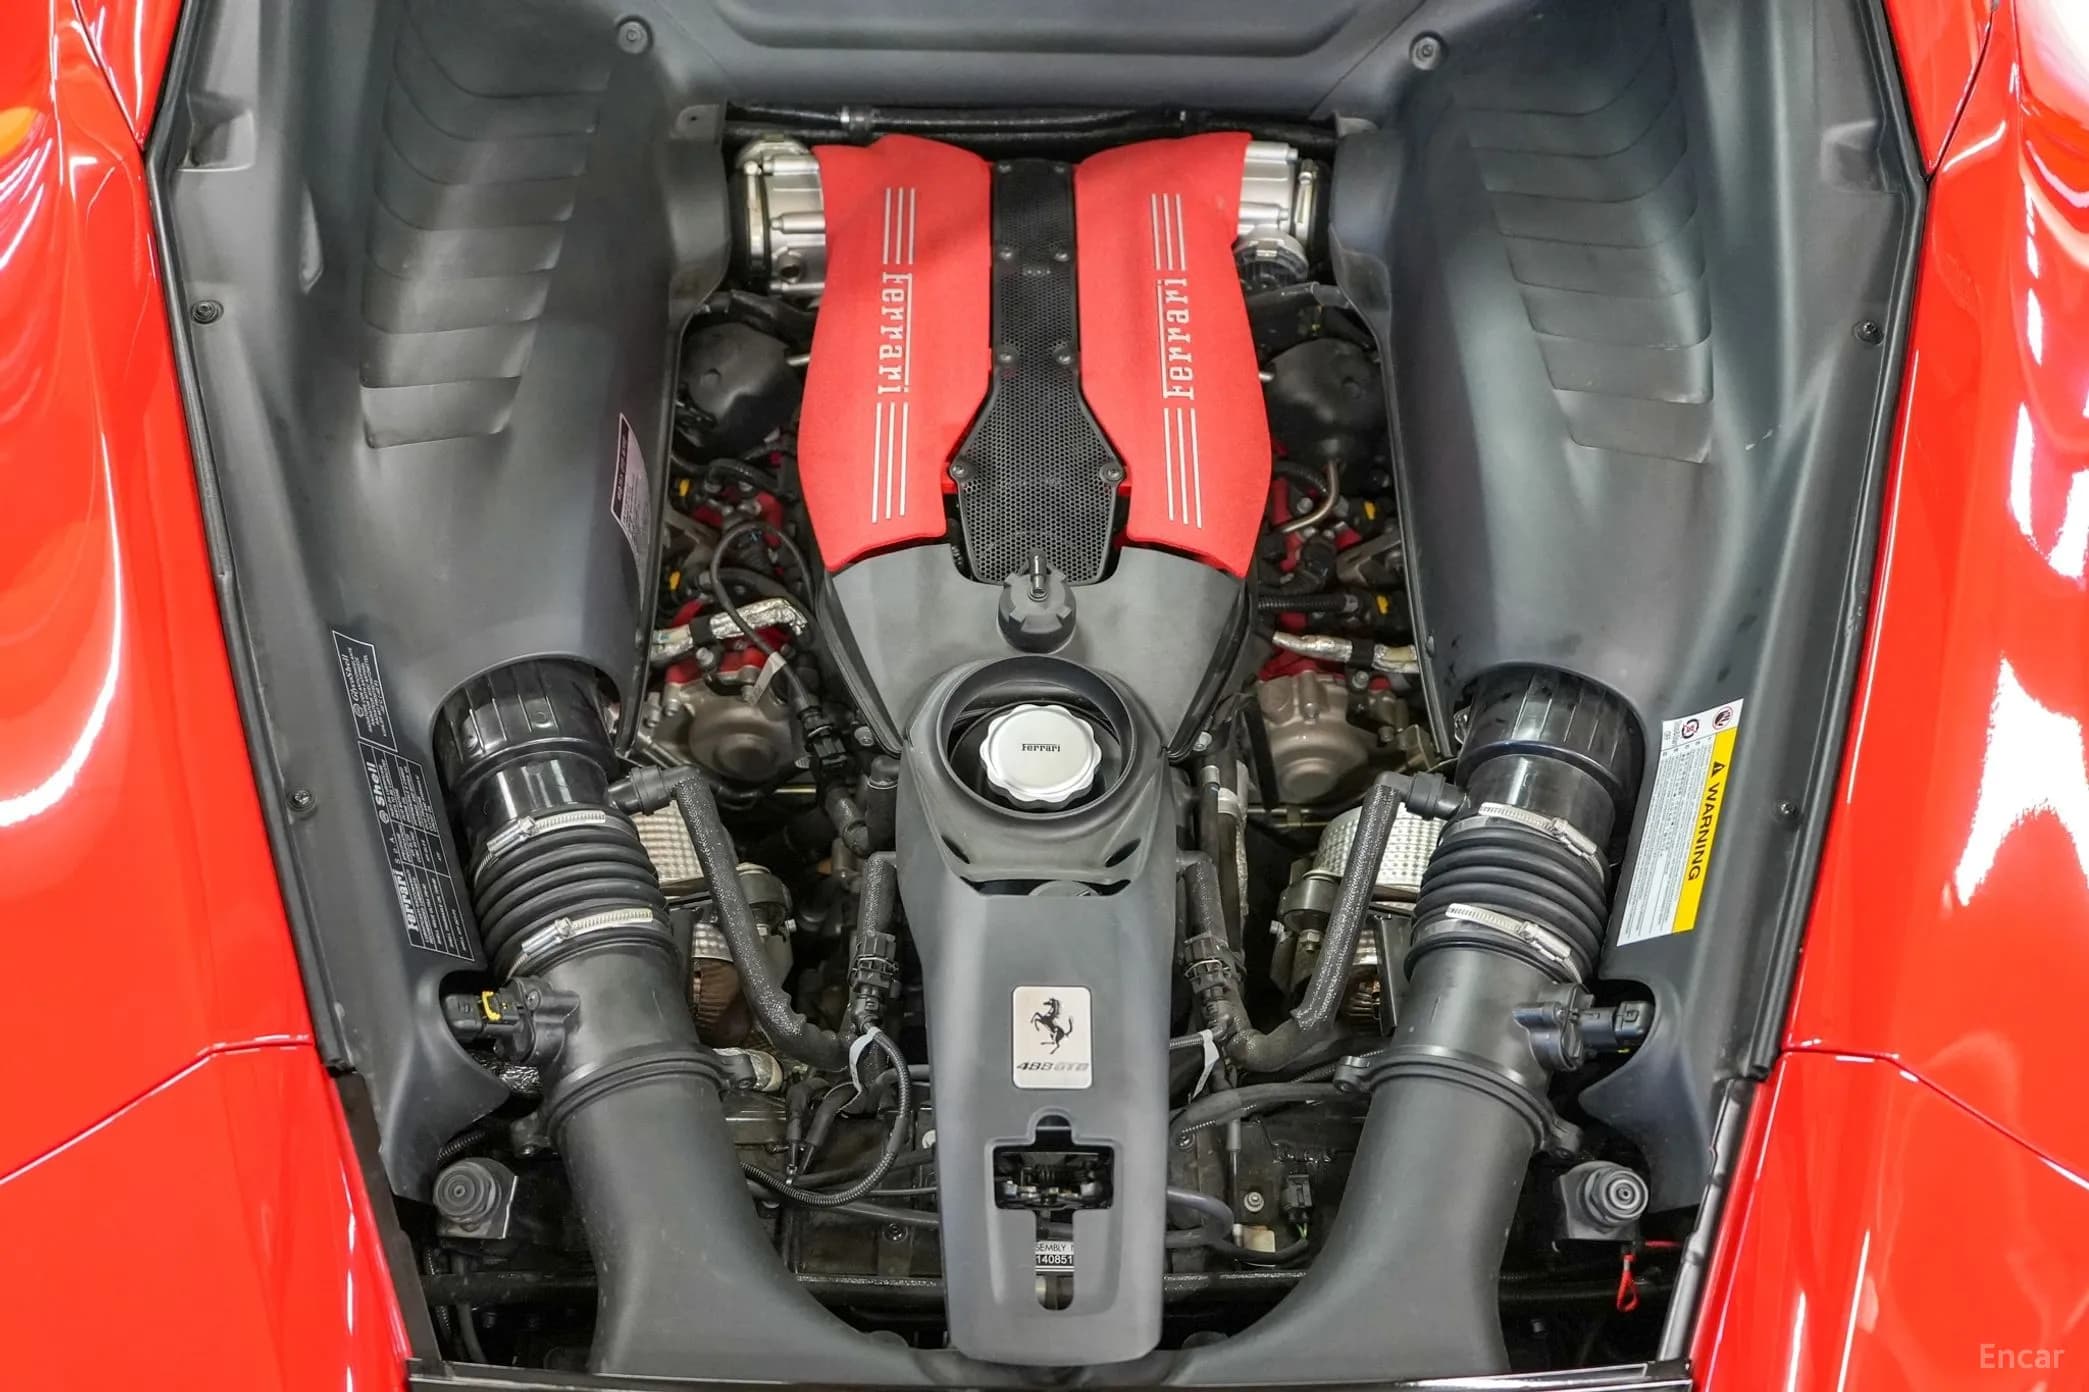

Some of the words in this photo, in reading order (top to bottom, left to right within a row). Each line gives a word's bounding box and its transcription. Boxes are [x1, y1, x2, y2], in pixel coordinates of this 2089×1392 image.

[877, 272, 913, 394] Ferrari
[1156, 277, 1195, 401] Ferrari
[1022, 743, 1061, 752] Ferrari
[366, 761, 385, 806] Shell
[1688, 782, 1720, 881] WARNING
[392, 868, 419, 931] Ferrari
[1036, 1255, 1073, 1265] 140851
